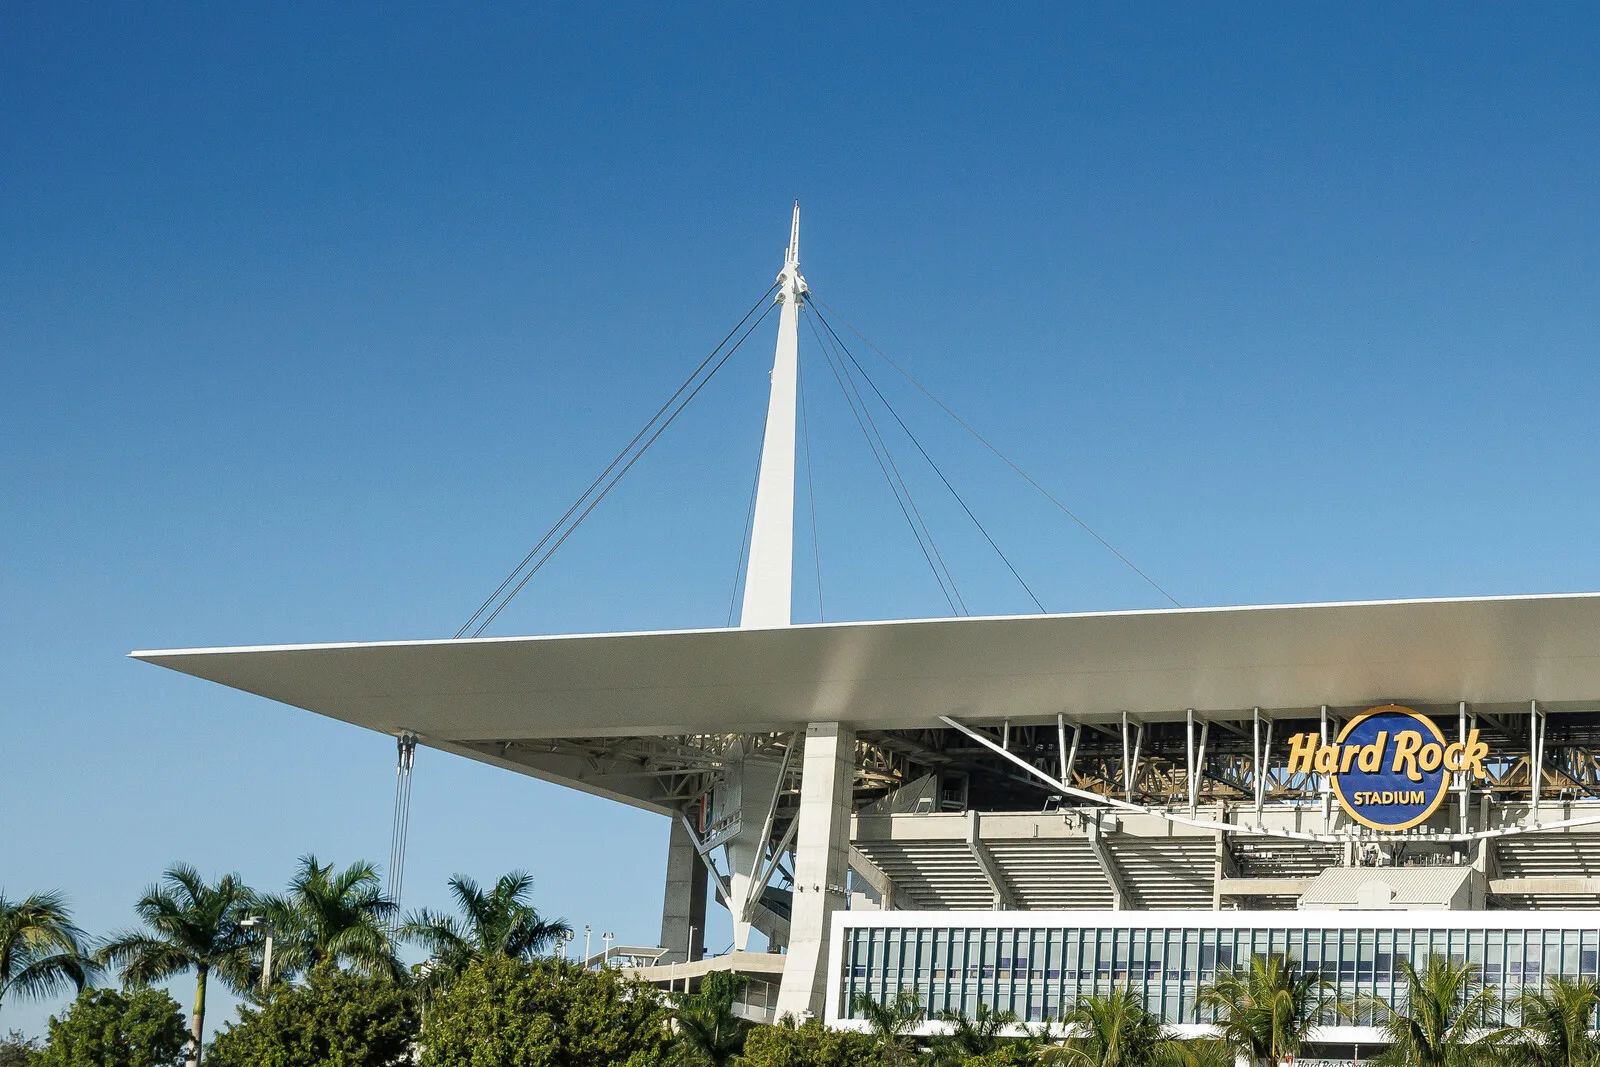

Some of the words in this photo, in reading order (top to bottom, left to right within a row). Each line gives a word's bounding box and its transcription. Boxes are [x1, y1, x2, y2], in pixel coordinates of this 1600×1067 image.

[1286, 731, 1390, 774] Hard
[1392, 728, 1489, 781] Rock
[1353, 791, 1426, 806] STADIUM
